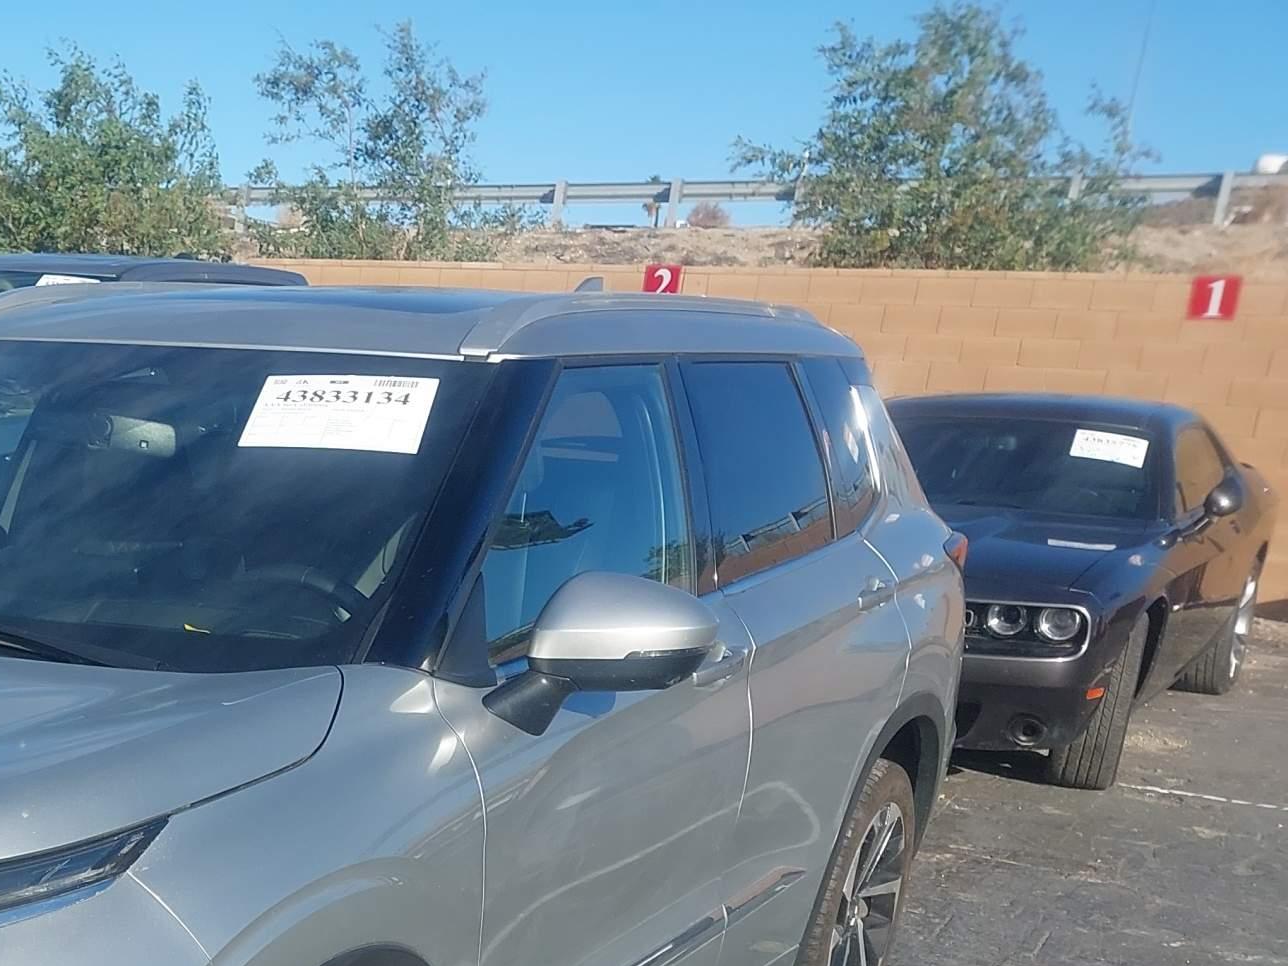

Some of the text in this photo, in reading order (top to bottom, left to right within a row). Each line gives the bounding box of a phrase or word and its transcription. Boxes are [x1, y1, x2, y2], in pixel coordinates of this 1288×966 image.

[653, 267, 672, 294] 2
[1200, 278, 1227, 319] 1
[275, 388, 412, 406] 43833134
